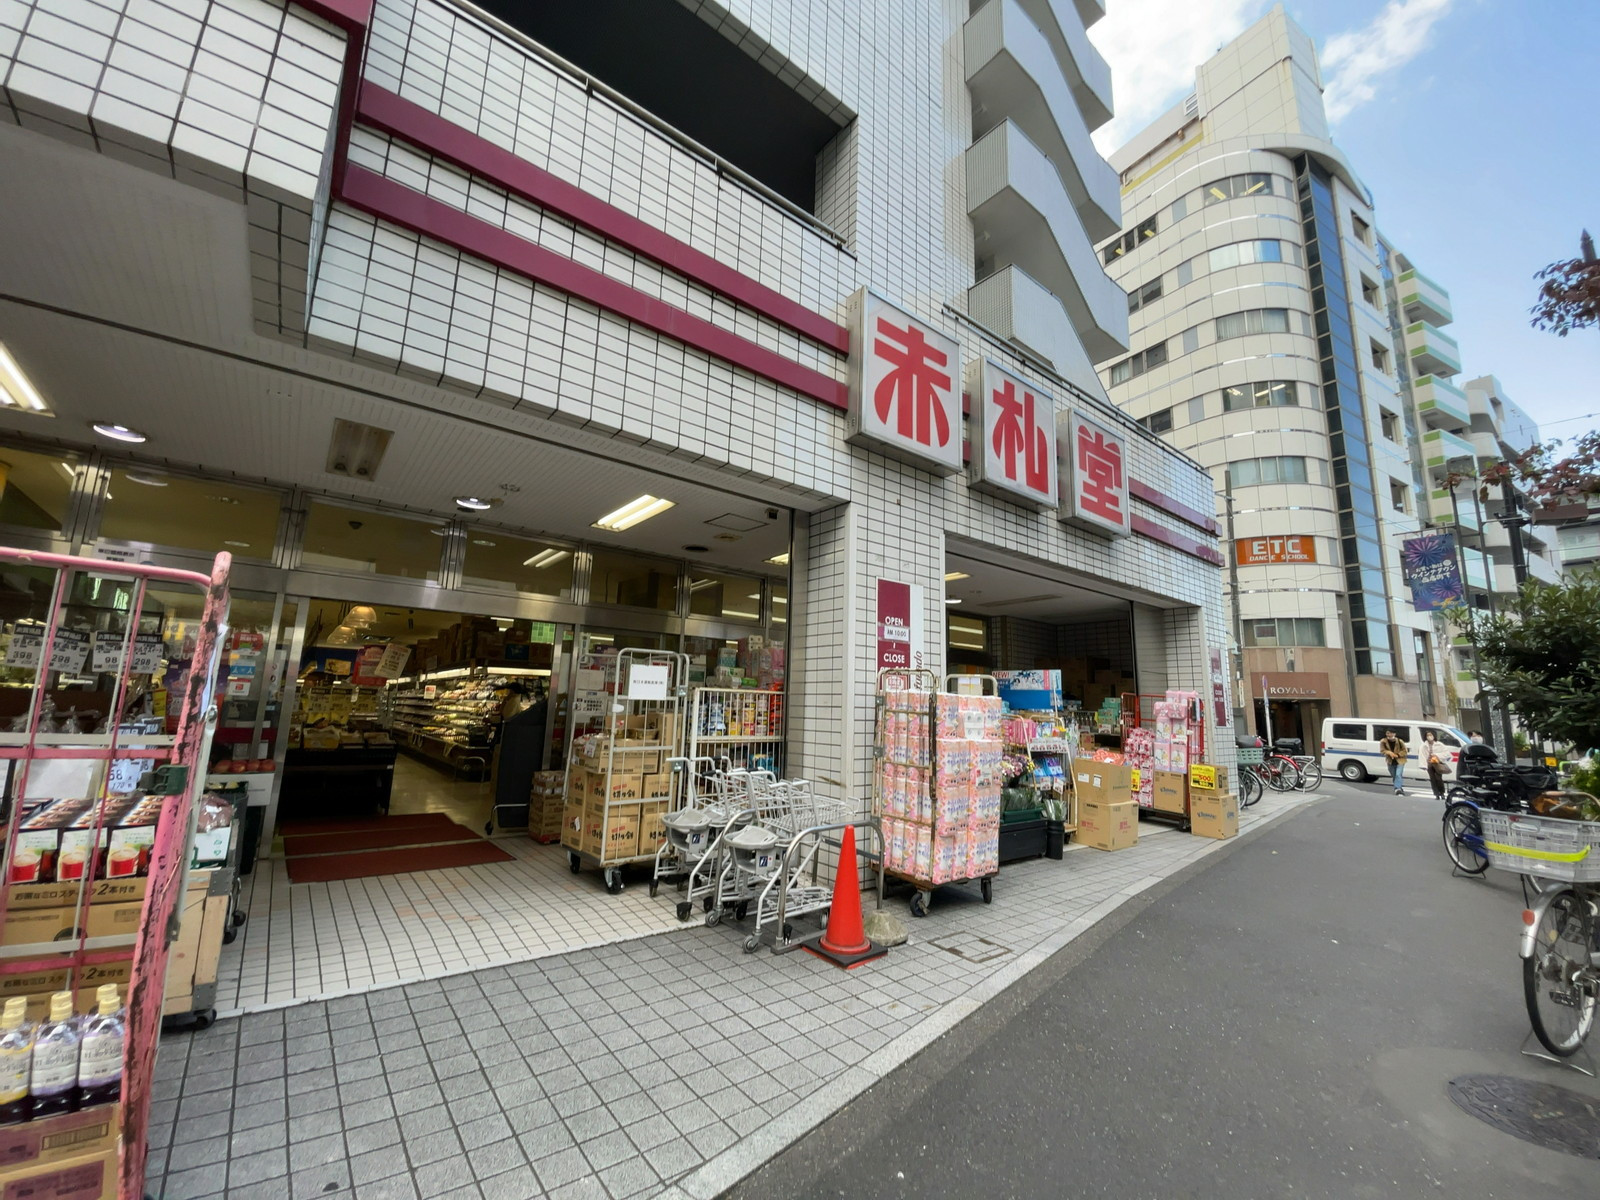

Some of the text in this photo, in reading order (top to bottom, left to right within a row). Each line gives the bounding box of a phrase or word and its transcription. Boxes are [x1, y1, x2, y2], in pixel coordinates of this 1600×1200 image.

[874, 316, 1124, 525] 赤札堂
[1252, 539, 1301, 555] ETC
[1249, 554, 1276, 562] DANCE
[885, 616, 904, 627] OPEN
[887, 628, 894, 636] AM
[883, 653, 905, 664] CLOSE
[1270, 687, 1306, 695] ROYAL
